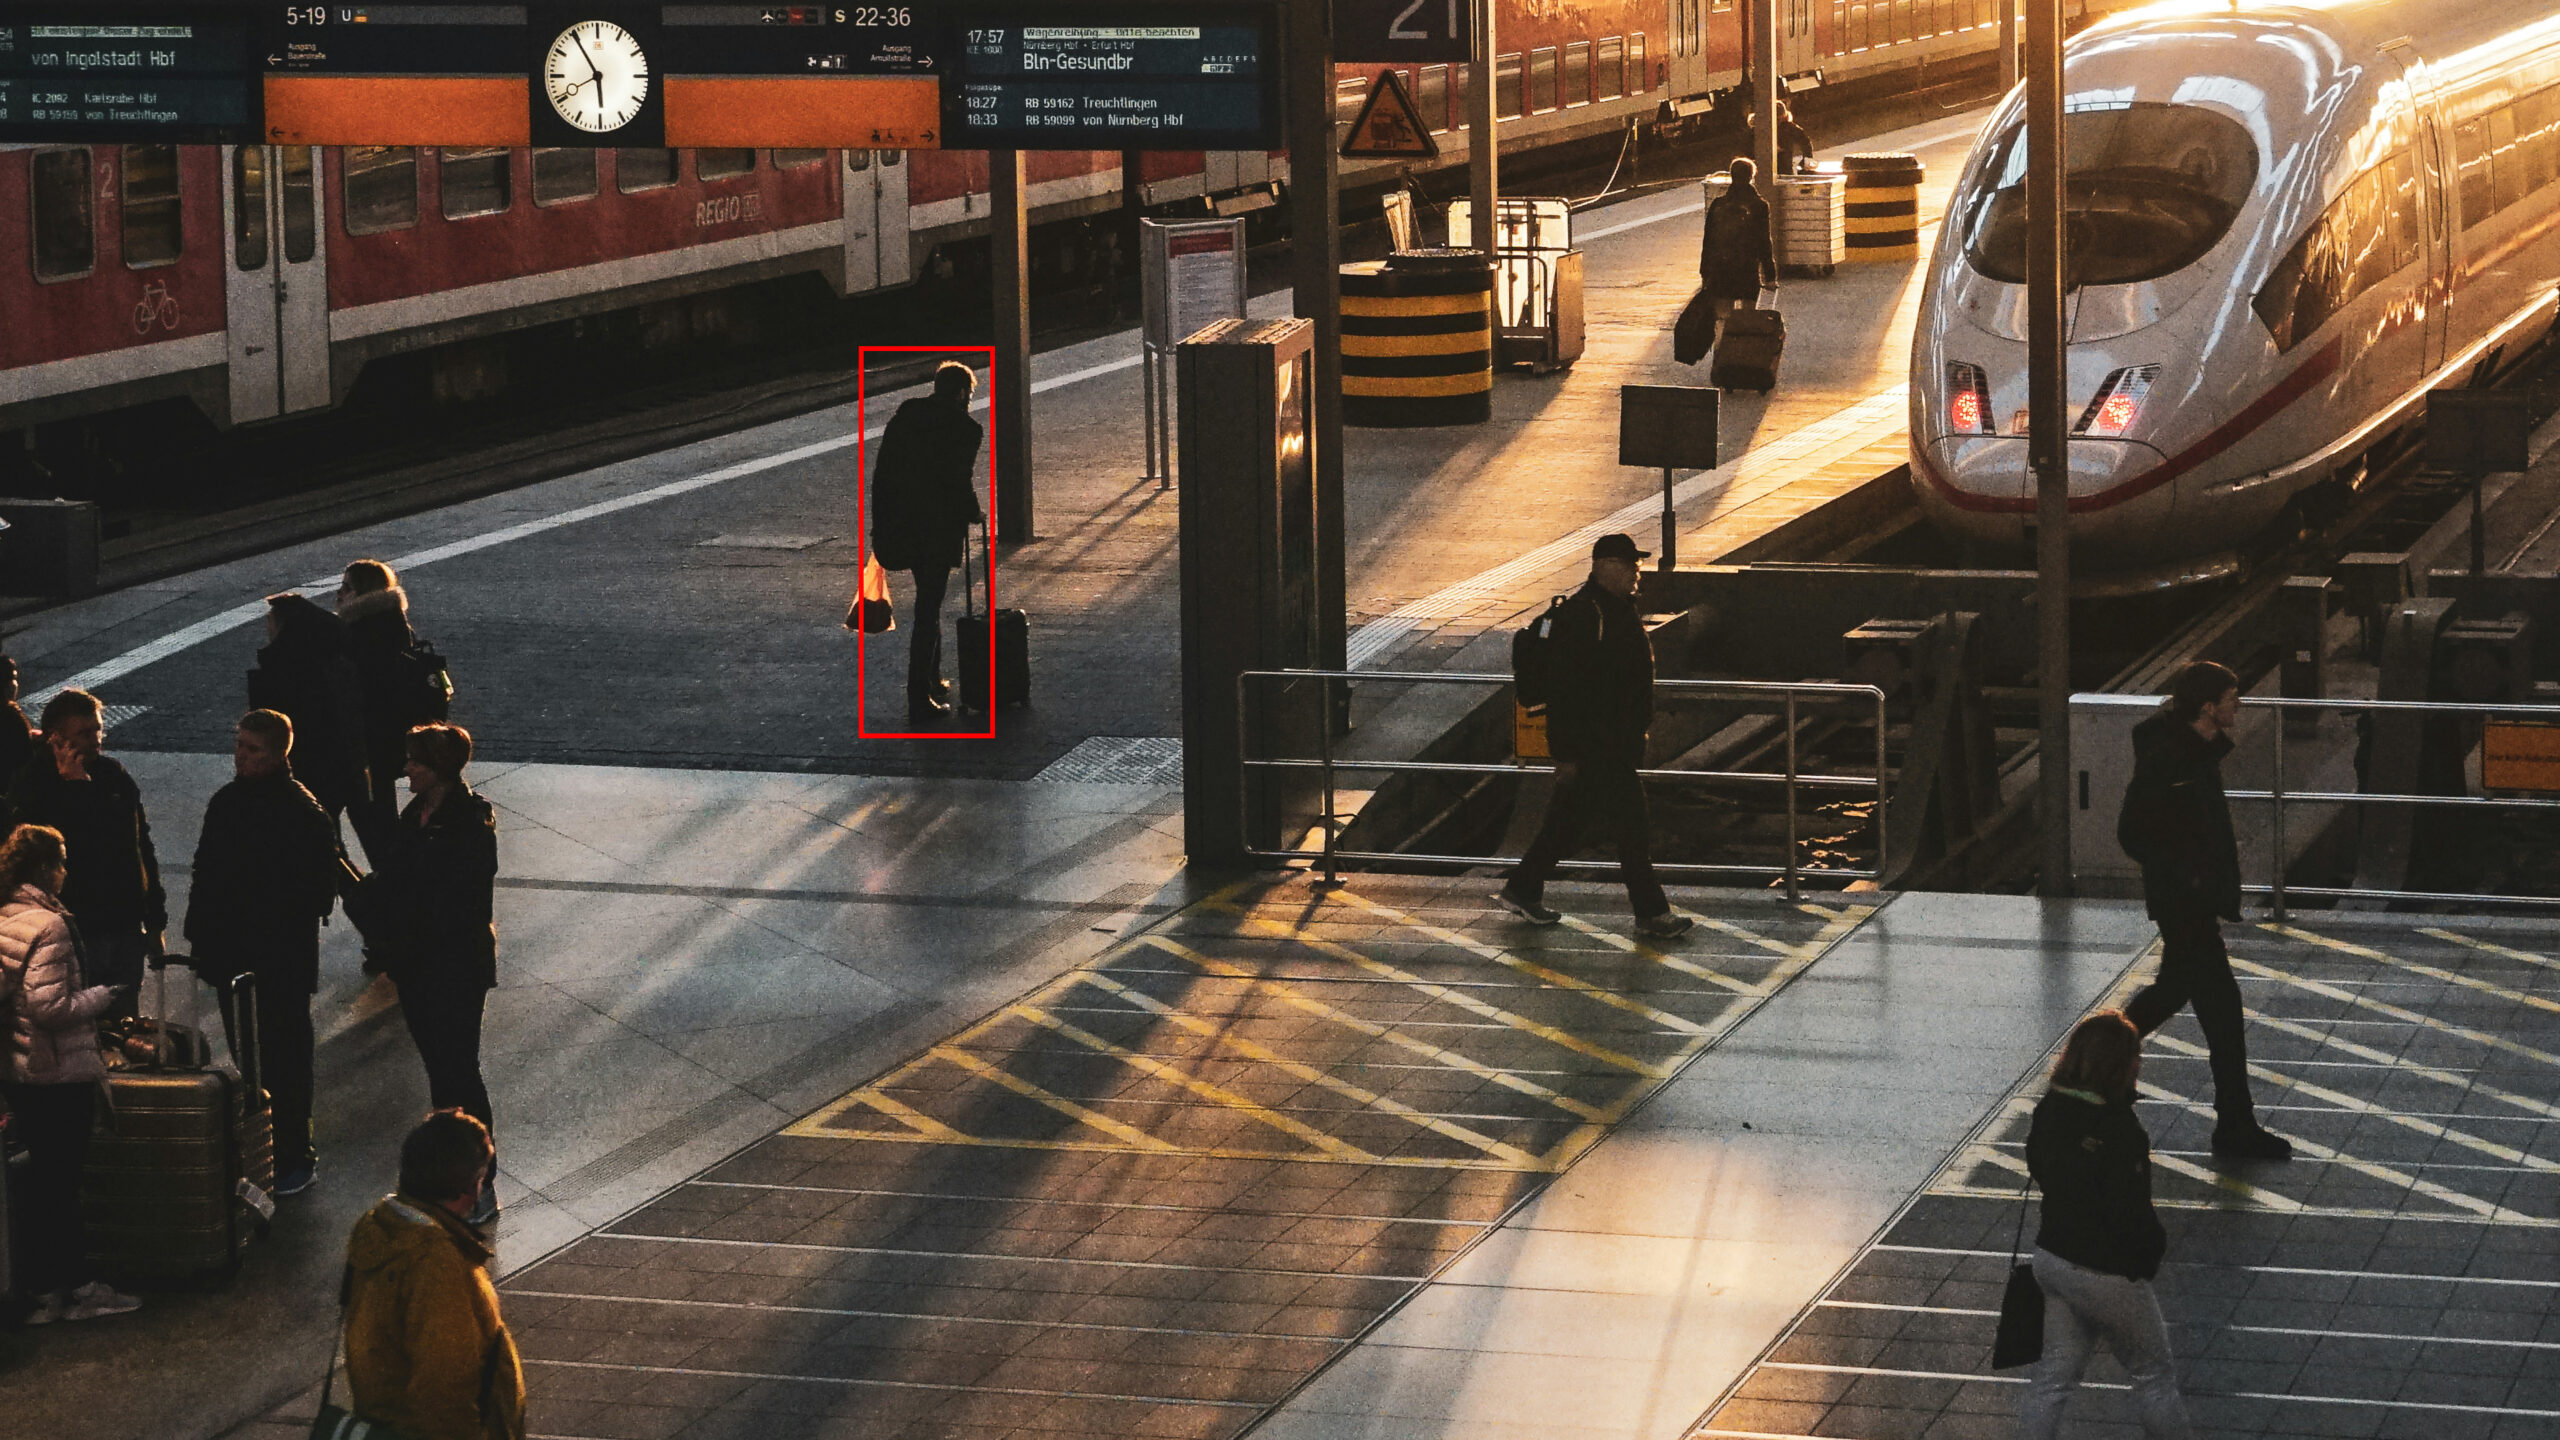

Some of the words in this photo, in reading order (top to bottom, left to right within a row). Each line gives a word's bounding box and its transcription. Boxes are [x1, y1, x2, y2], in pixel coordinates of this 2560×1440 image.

[287, 6, 326, 25] 5-19
[342, 9, 351, 22] U
[835, 9, 846, 23] S
[856, 7, 911, 26] 22-36
[967, 29, 1004, 44] 17:57
[32, 53, 59, 66] von
[66, 50, 142, 70] Ingolstadt
[150, 50, 176, 66] Hbf
[1023, 53, 1134, 70] Bln-Gesundbr
[1025, 98, 1039, 109] RB
[1043, 97, 1075, 109] 59162
[1083, 96, 1158, 111] Treuchtlingen
[967, 113, 998, 126] 18:33
[1025, 115, 1040, 126] RB
[1044, 115, 1075, 126] 59099
[1083, 116, 1103, 126] von
[1164, 113, 1184, 126] Hbf
[100, 162, 114, 198] 2
[696, 196, 740, 227] REGIO
